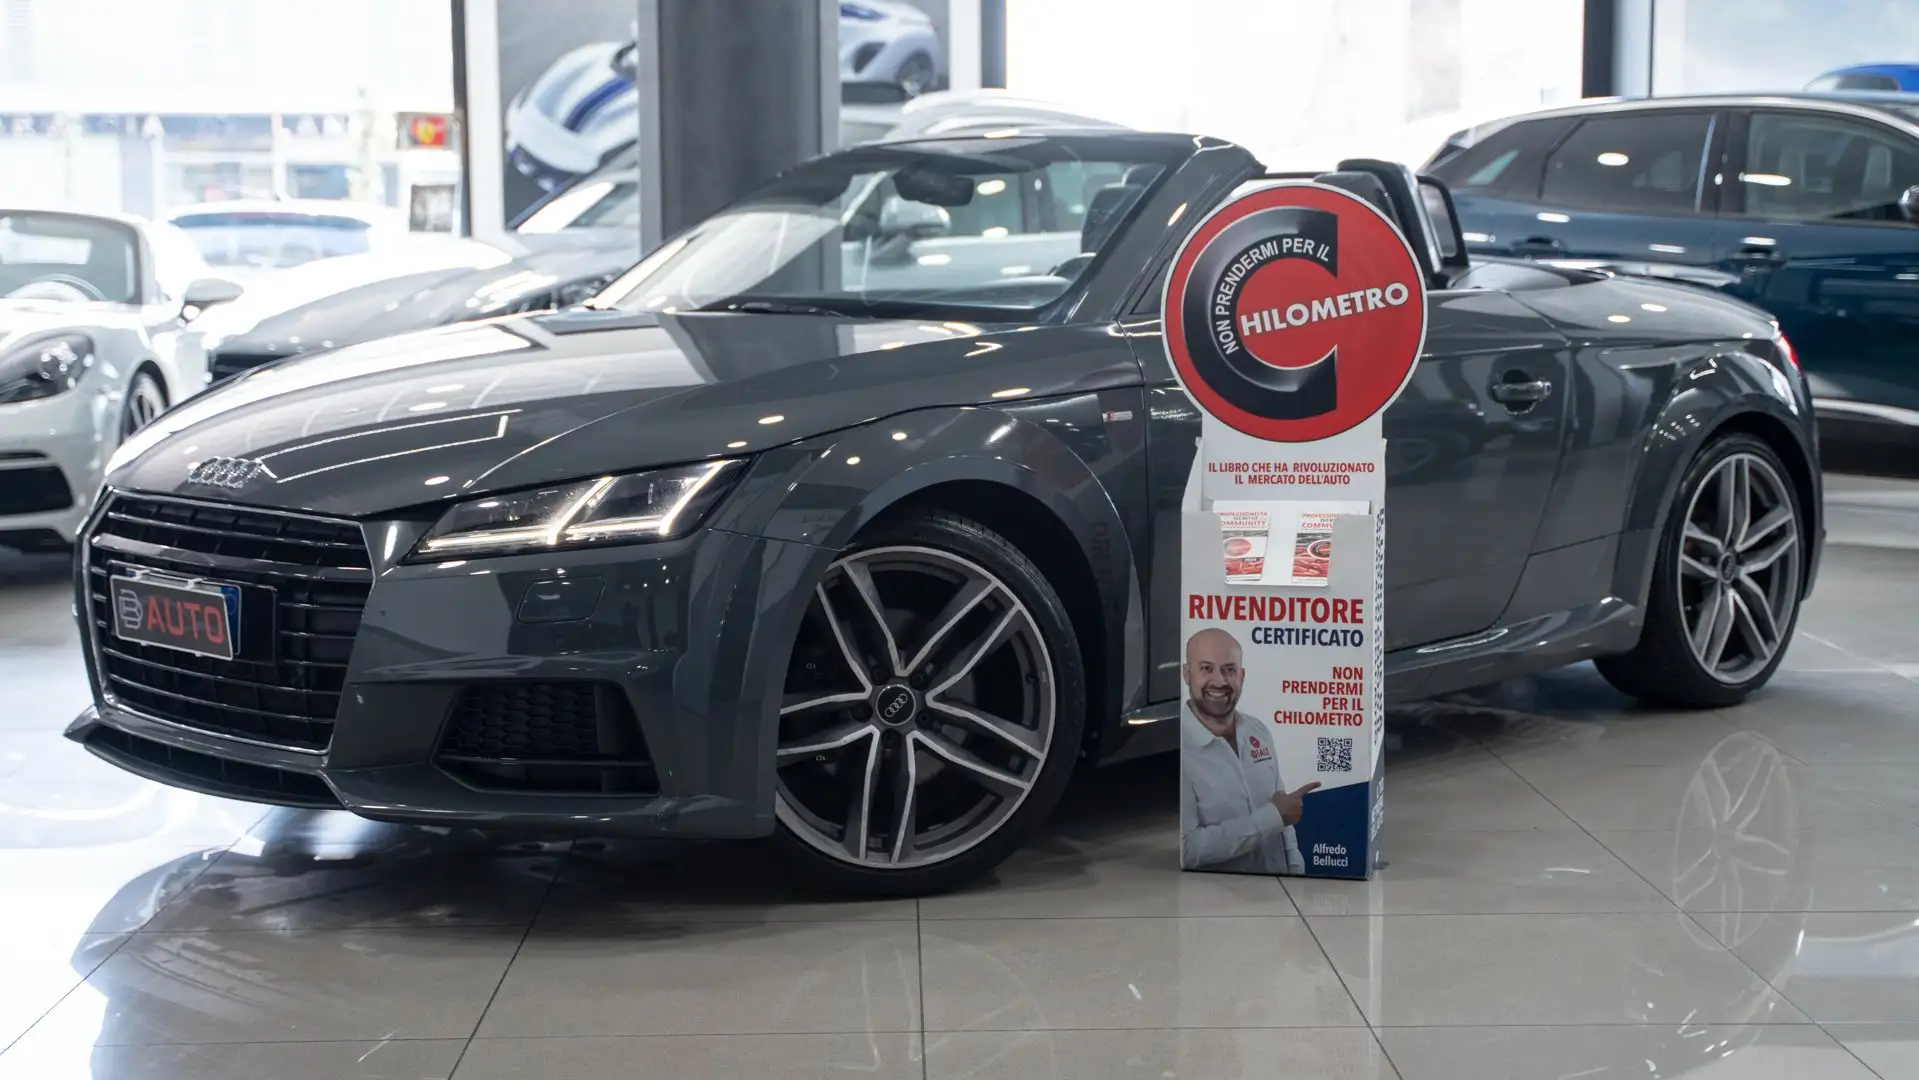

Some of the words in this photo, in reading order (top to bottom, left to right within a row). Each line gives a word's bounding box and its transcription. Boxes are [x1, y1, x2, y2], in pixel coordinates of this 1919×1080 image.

[1282, 238, 1315, 255] PER
[1316, 244, 1330, 262] IL
[1215, 241, 1278, 315] PRENDERMI
[1215, 319, 1239, 354] NON
[1208, 462, 1217, 473] IL
[1220, 462, 1249, 473] LIBRO
[1252, 463, 1271, 473] CHE
[1274, 462, 1288, 473] HA
[1293, 463, 1375, 473] RIVOLUZIONATO
[1235, 475, 1244, 484] IL
[1248, 474, 1295, 485] MERCATO
[1298, 474, 1350, 485] DELL'AUTO
[1189, 595, 1364, 624] RIVENDITORE
[147, 595, 224, 645] AUTO
[1251, 627, 1364, 647] CERTIFICATO
[1332, 667, 1363, 680] NON
[1282, 680, 1363, 695] PRENDERMI
[1322, 697, 1347, 711] PER
[1352, 698, 1364, 711] IL
[1274, 711, 1363, 726] CHILOMETRO
[1313, 844, 1346, 855] Alfredo
[1313, 856, 1348, 867] Bellucci
